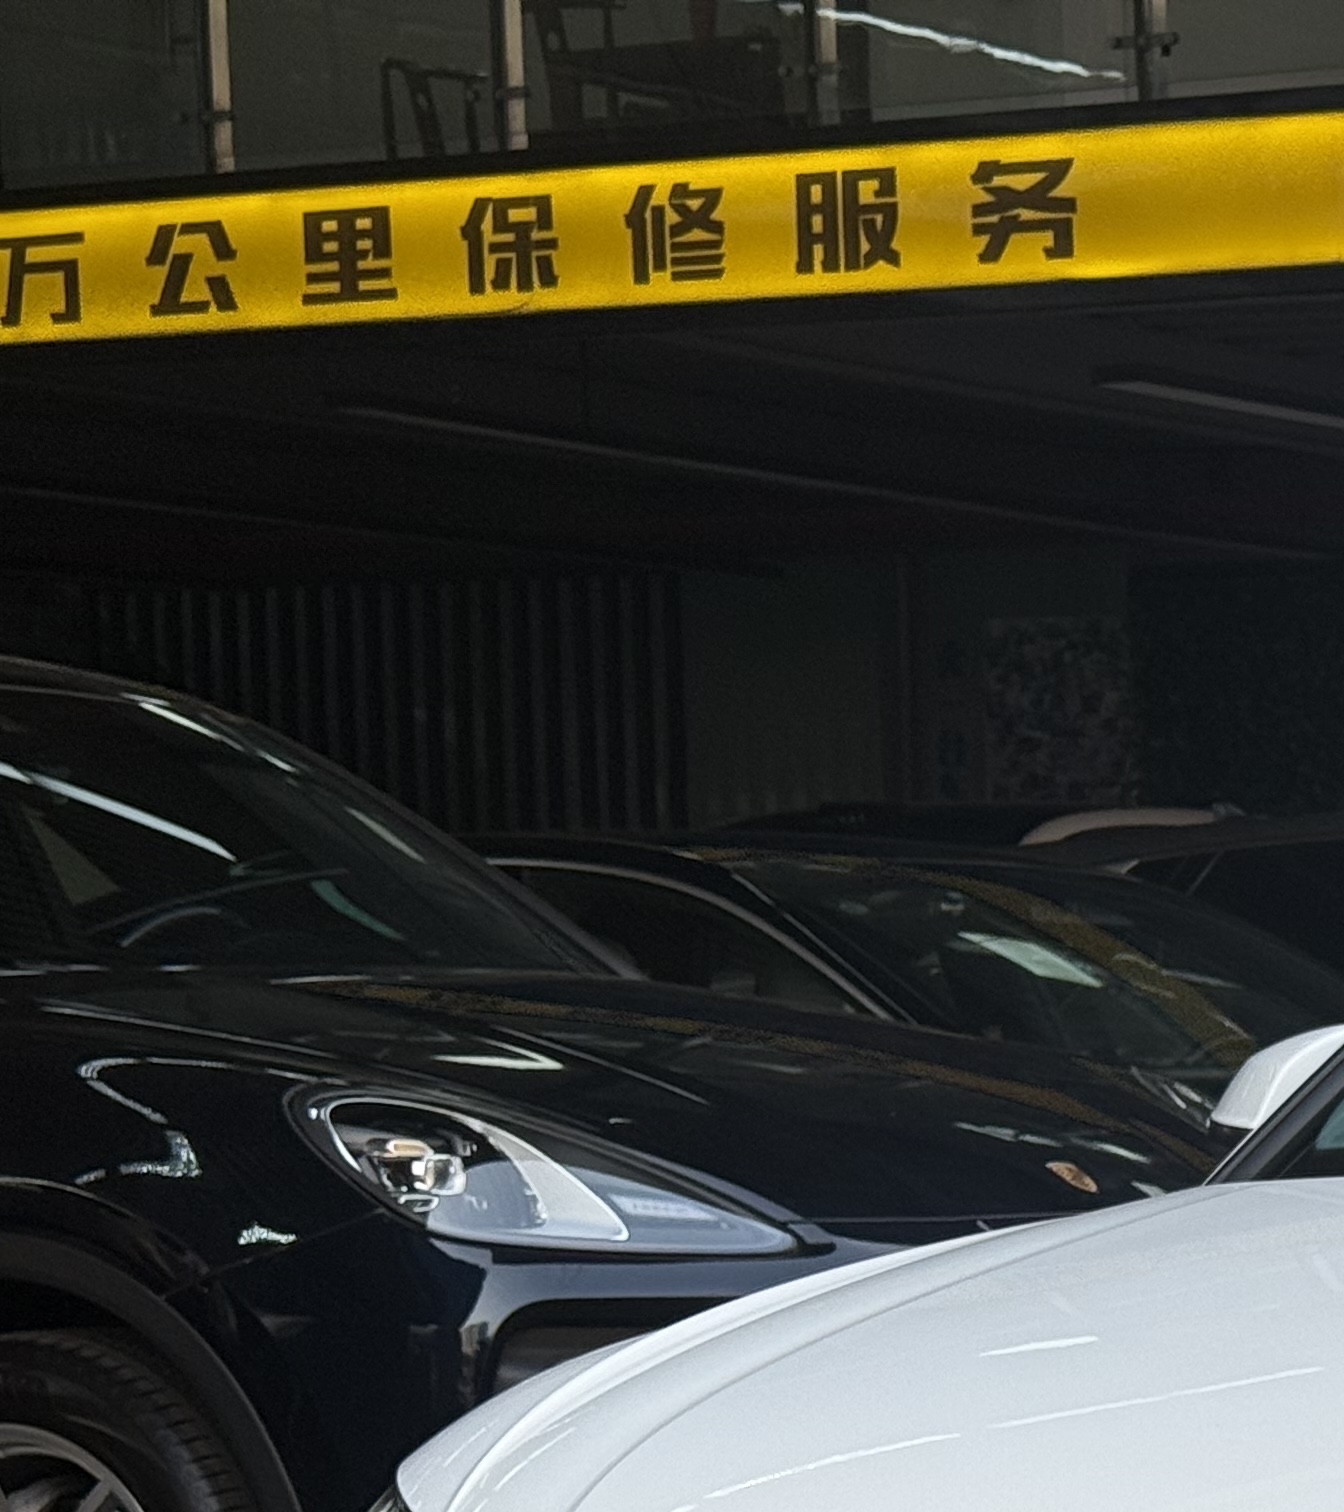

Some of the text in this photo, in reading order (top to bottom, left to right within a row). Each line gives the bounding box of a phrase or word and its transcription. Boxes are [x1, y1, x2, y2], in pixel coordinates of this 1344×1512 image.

[0, 158, 1077, 327] 万公里保修服务
